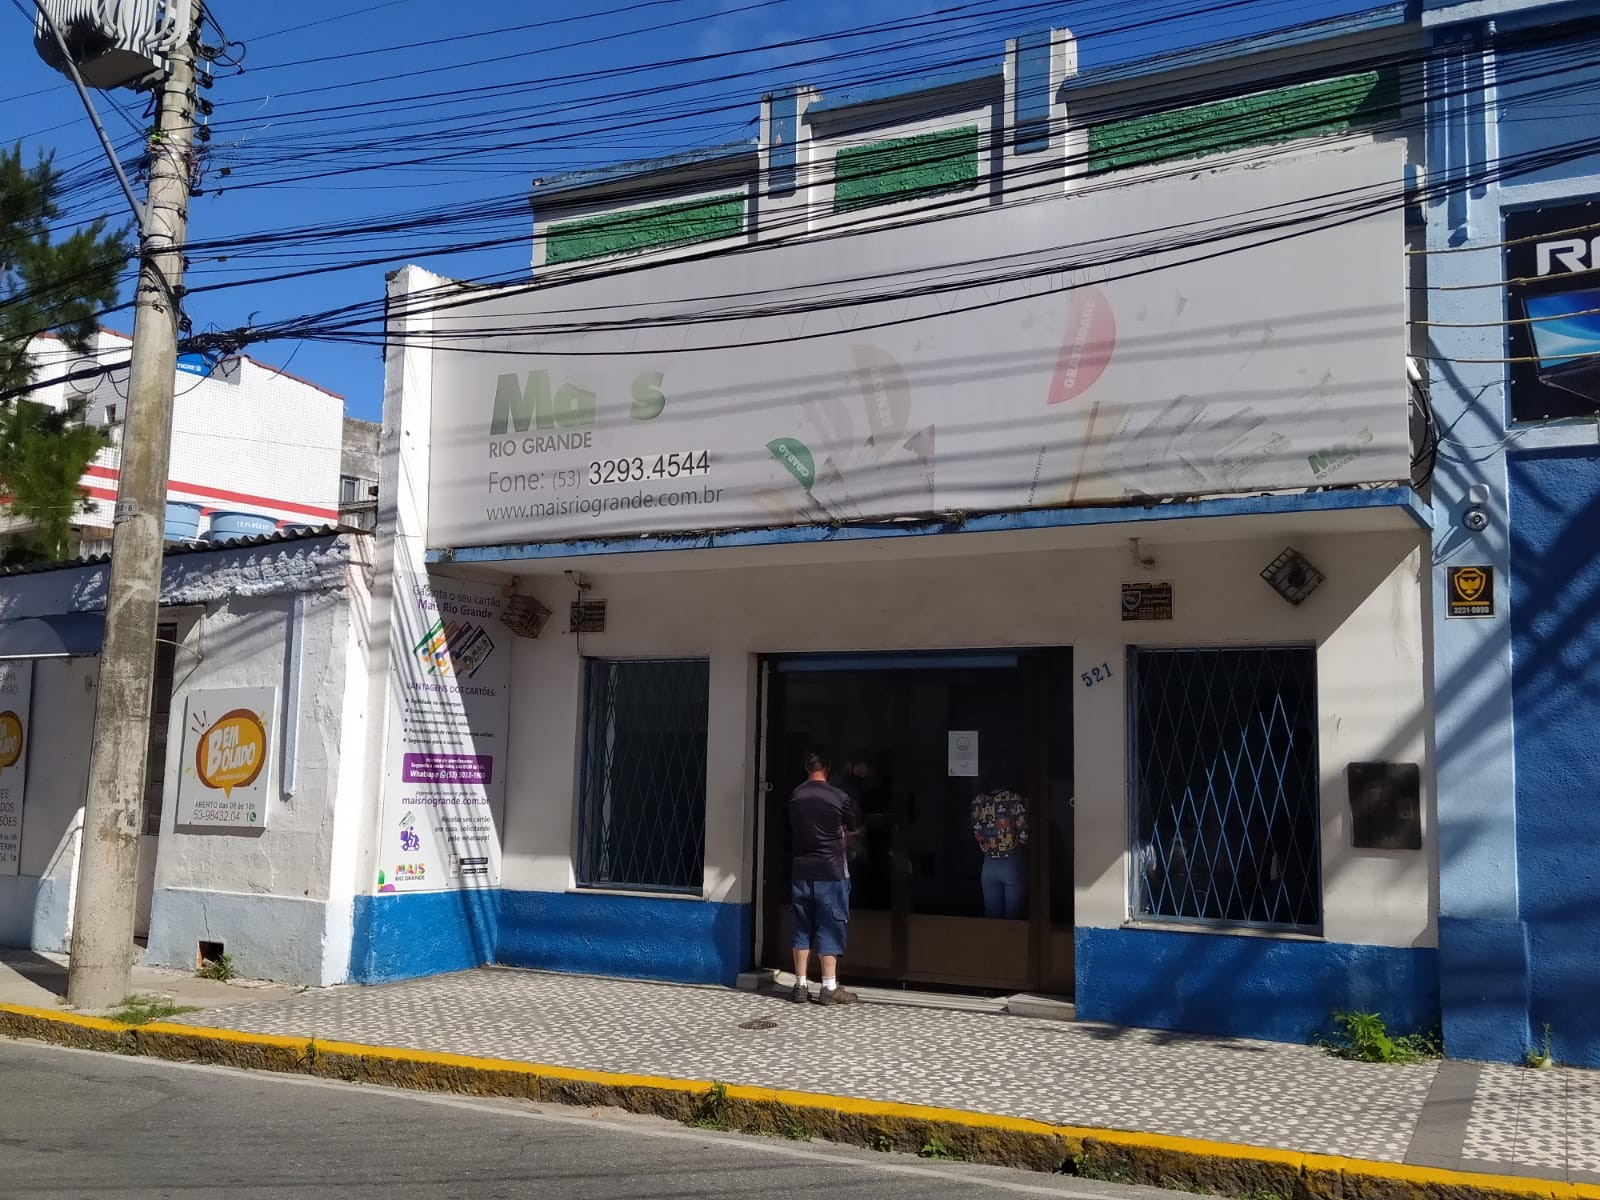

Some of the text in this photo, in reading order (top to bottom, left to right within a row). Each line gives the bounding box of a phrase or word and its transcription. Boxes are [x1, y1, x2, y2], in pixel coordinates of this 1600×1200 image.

[1536, 238, 1600, 277] R
[488, 431, 593, 459] RIO GRANDE
[488, 450, 711, 494] Fone: (53) 3293.4544
[486, 484, 725, 521] www.maisriogrande.com.br
[417, 599, 493, 618] Mais Rio Grande
[457, 593, 472, 604] seu
[474, 596, 501, 607] cartão
[1081, 663, 1112, 687] 521
[406, 682, 448, 693] VANTAGENS
[449, 686, 465, 694] DOS
[219, 801, 228, 809] das
[402, 796, 490, 807] maisriogrande.com.br
[395, 863, 425, 875] MAIS
